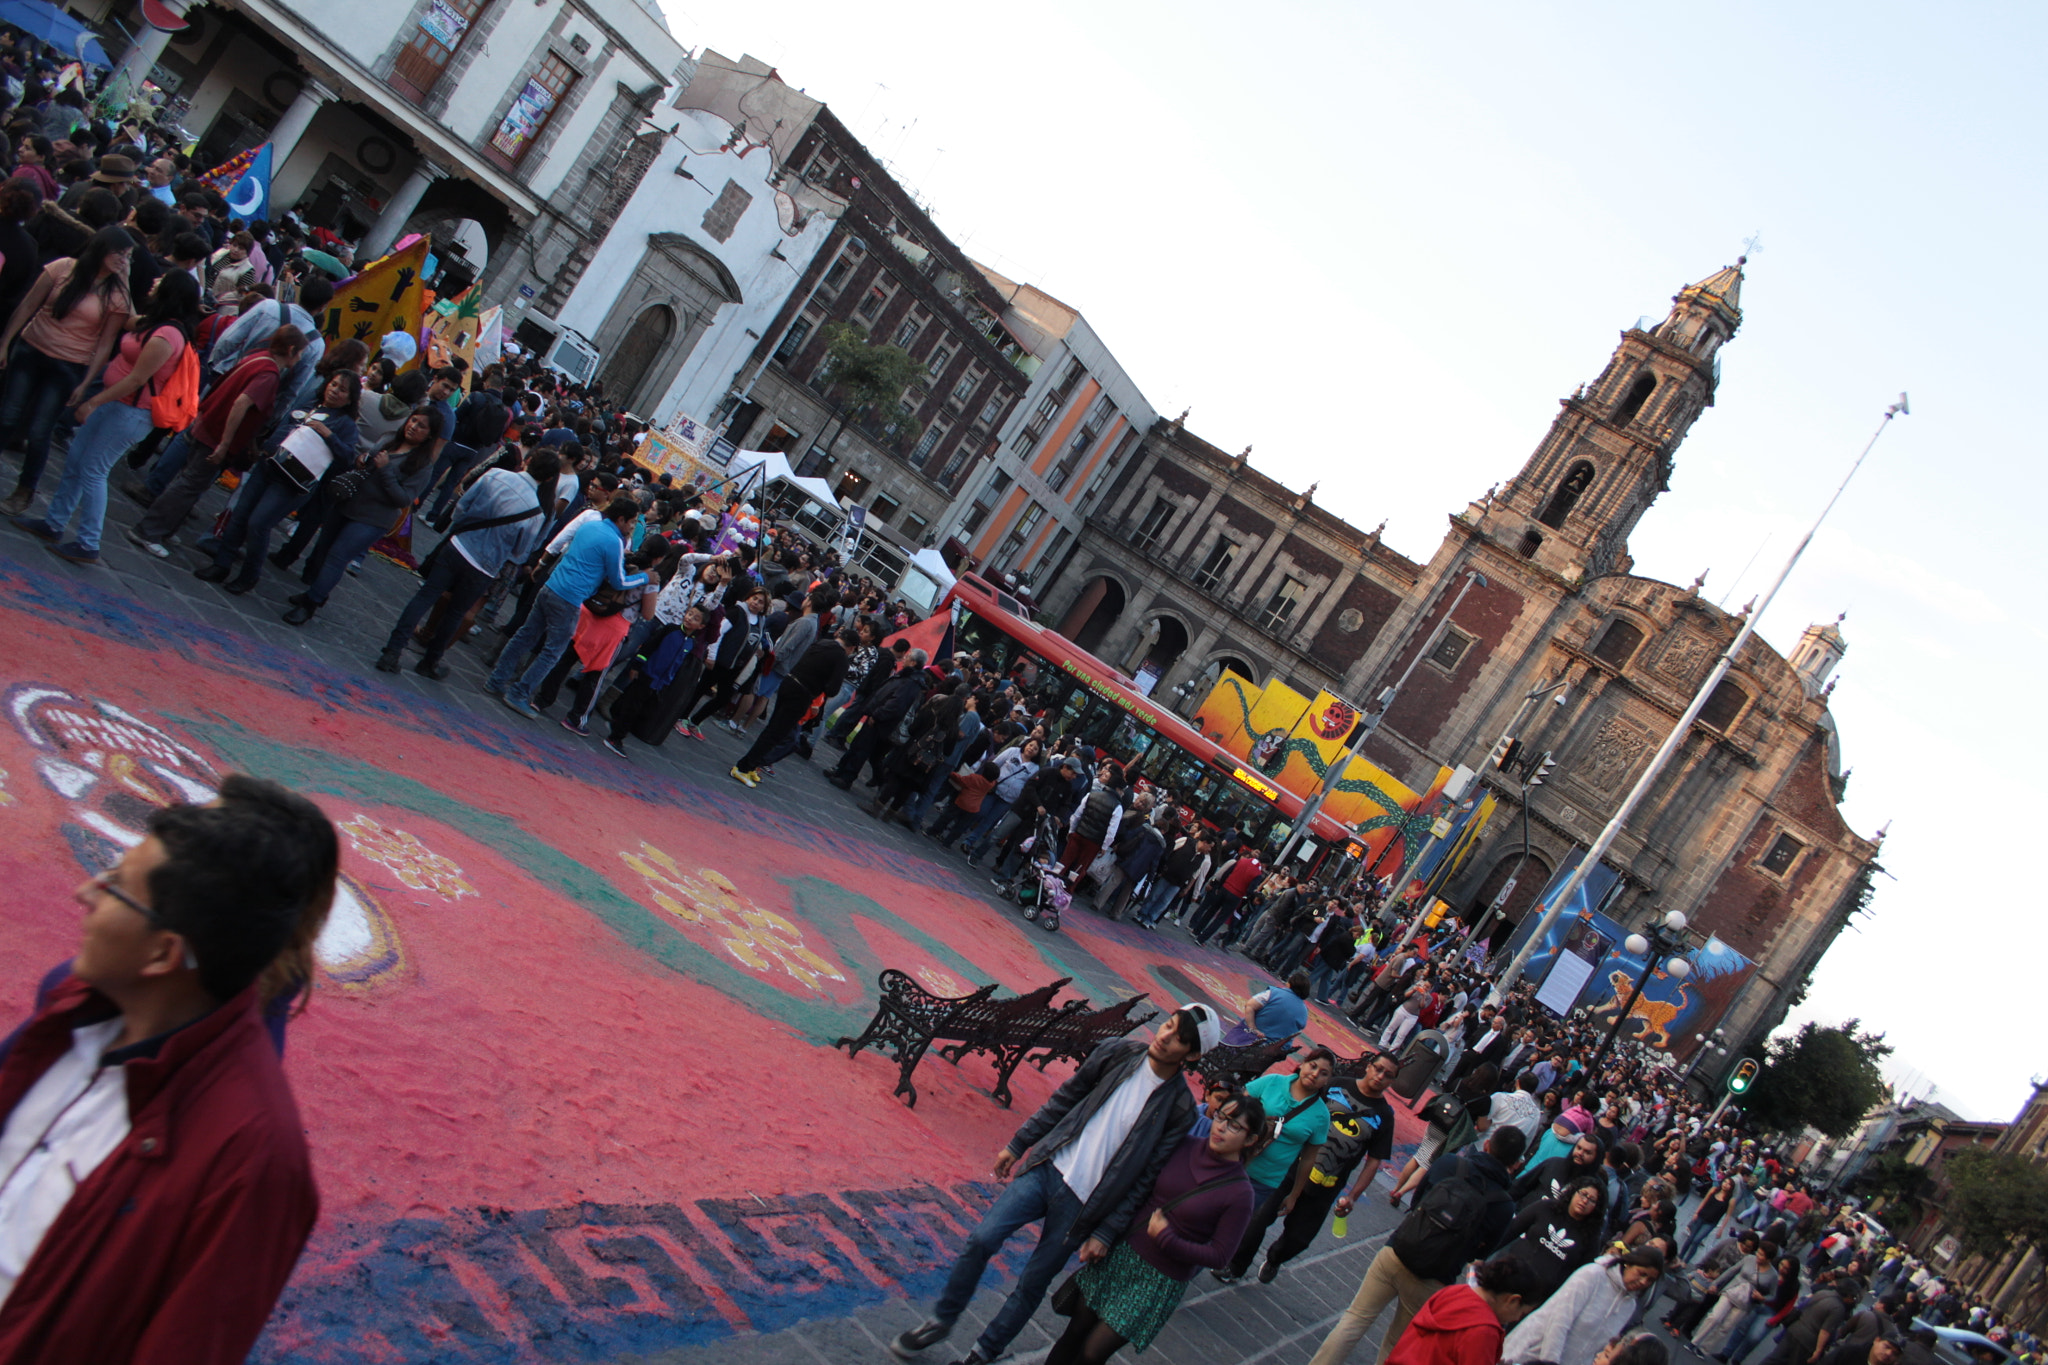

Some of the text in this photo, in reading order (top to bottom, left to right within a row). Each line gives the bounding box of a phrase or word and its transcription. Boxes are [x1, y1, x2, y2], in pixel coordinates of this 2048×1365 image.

[1062, 660, 1077, 673] Por
[1076, 671, 1092, 683] una
[1091, 679, 1121, 701] ciudad
[1136, 708, 1158, 726] verde
[1539, 1236, 1567, 1261] adidas
